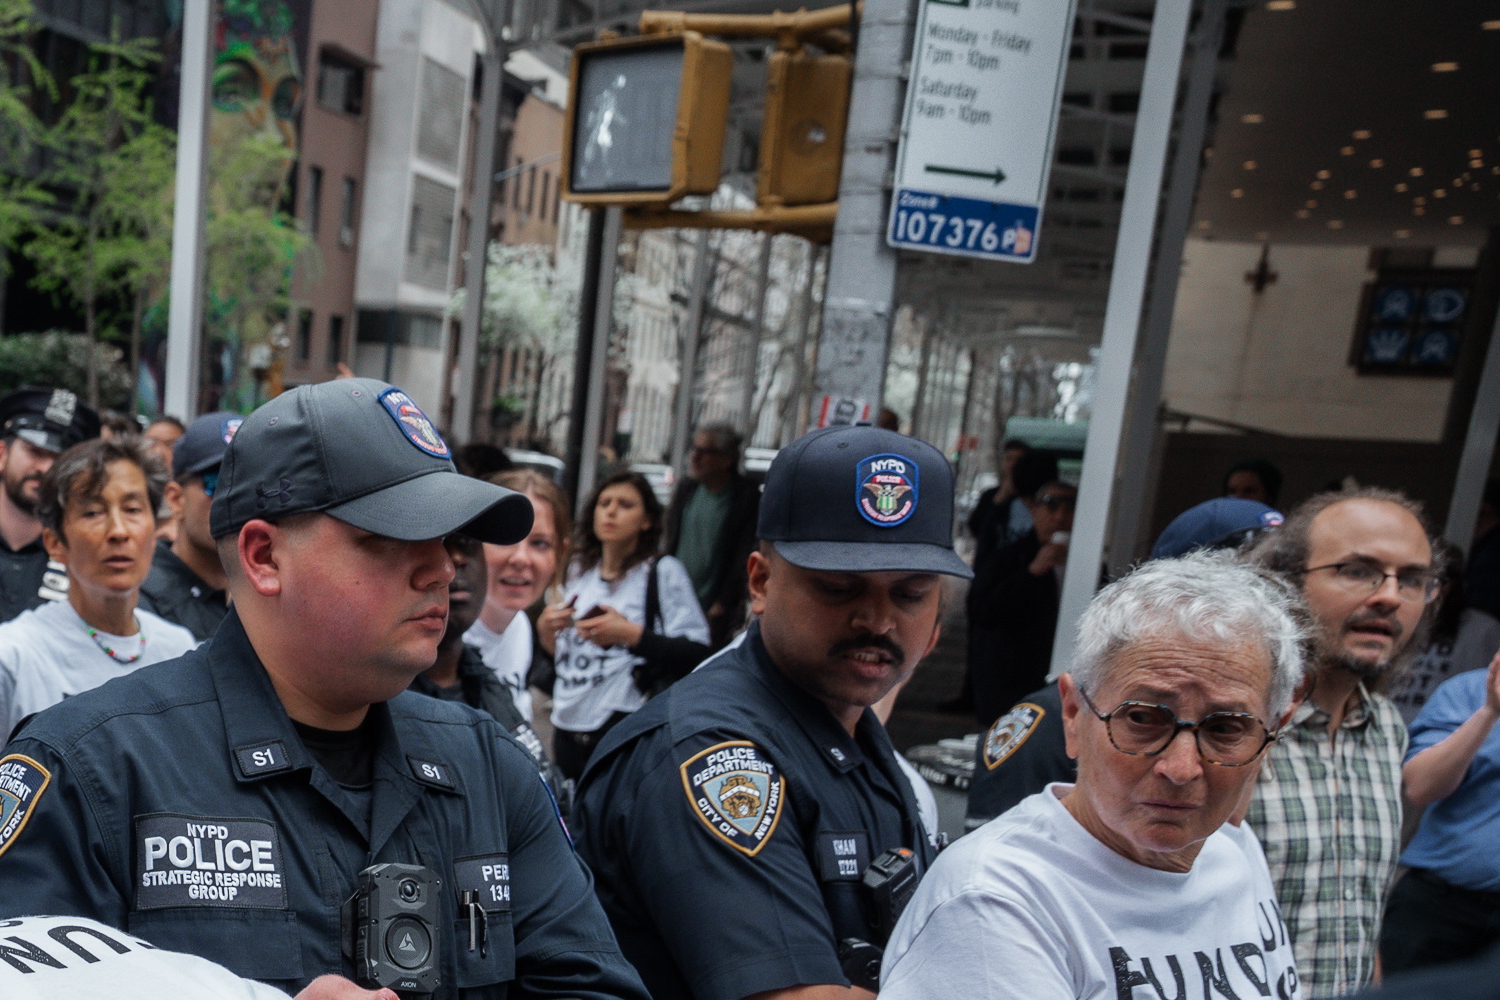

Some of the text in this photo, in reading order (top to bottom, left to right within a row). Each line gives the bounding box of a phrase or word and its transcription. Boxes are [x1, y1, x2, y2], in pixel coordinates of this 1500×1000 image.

[928, 23, 978, 46] Monday
[991, 29, 1032, 56] Friday
[920, 75, 978, 102] Saturday
[896, 210, 999, 251] 107376
[871, 459, 906, 473] NYPD
[251, 748, 276, 767] S1
[706, 747, 757, 767] POLICE
[421, 763, 442, 780] S1
[692, 758, 774, 787] DEPARTMENT
[697, 797, 739, 838] CITY OF
[753, 781, 780, 841] NEW YORK
[186, 823, 229, 840] NYPD
[144, 835, 276, 872] POLICE
[832, 838, 857, 856] KHAN
[142, 869, 282, 888] STRATEGIC RESPONSE
[481, 864, 510, 881] PER
[188, 884, 238, 901] GROUP
[489, 884, 510, 902] 134
